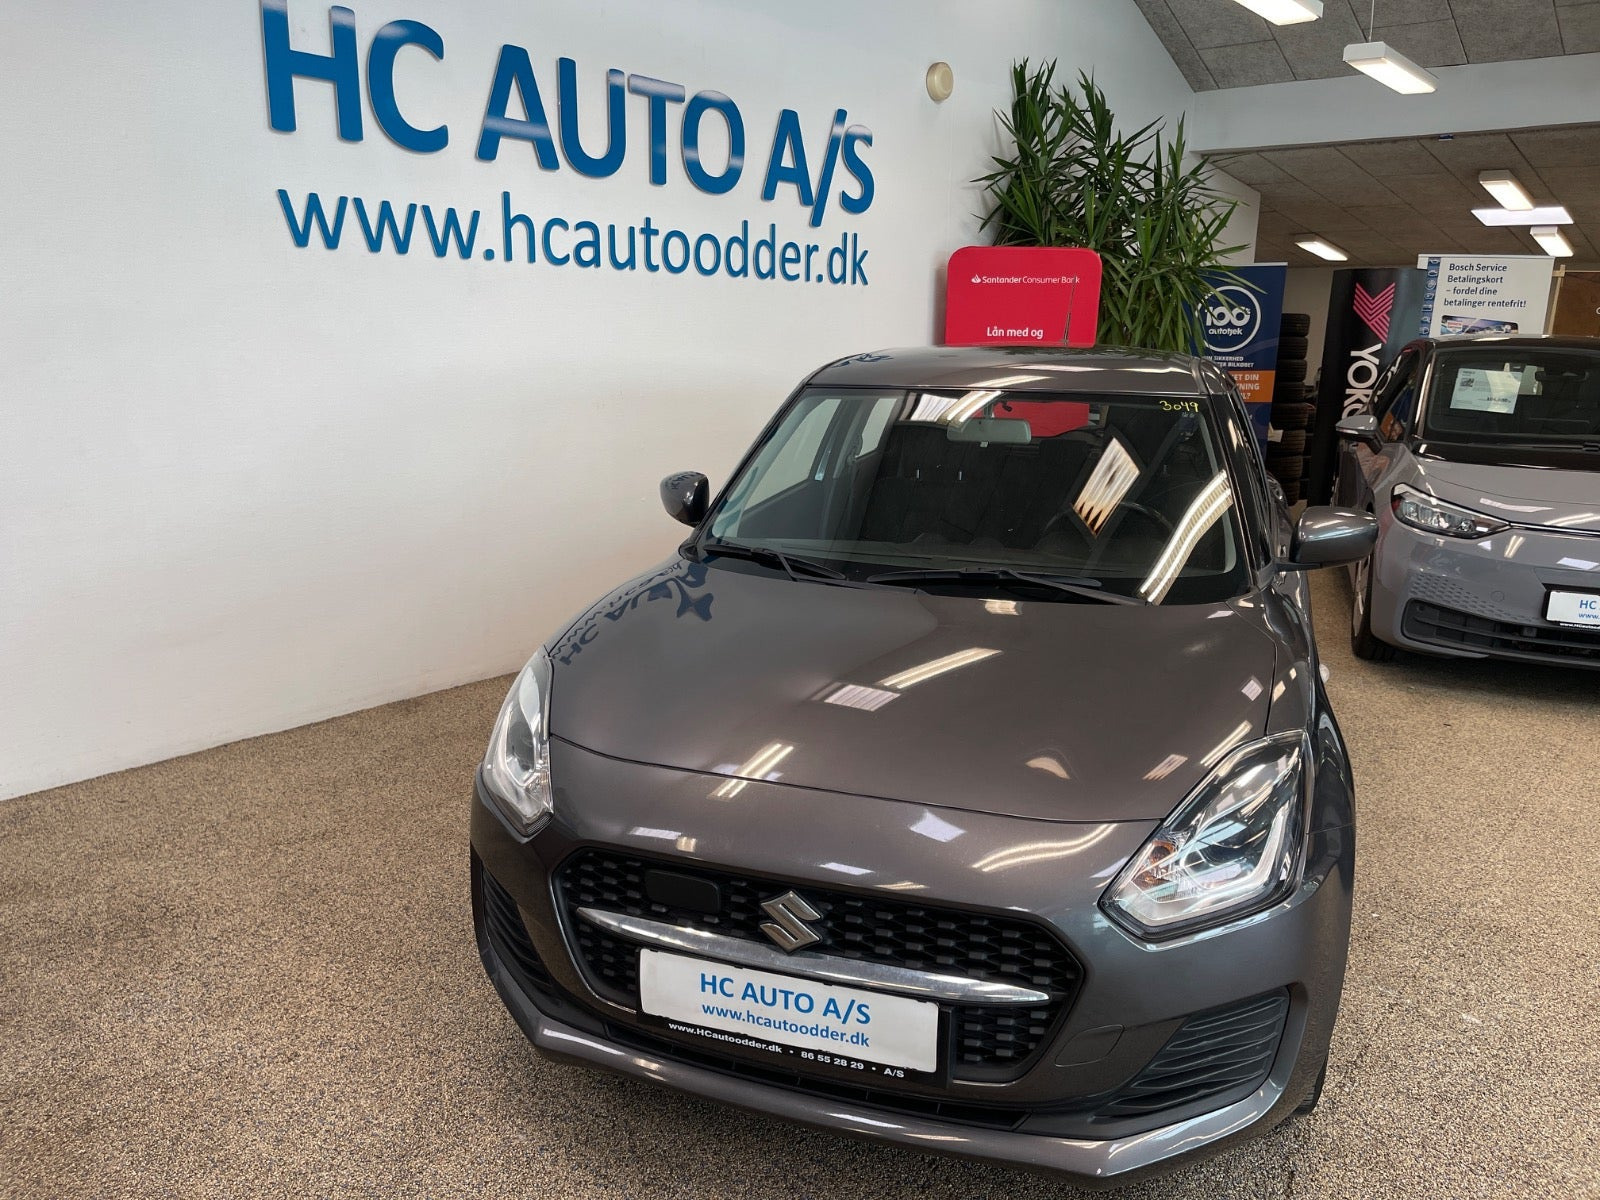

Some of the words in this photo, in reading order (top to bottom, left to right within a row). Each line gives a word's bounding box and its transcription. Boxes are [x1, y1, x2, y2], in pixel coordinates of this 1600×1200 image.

[260, 0, 449, 153] HC
[476, 44, 745, 194] AUTO
[764, 108, 874, 227] A/S
[277, 188, 869, 286] www.hcautoodder.dk
[1449, 263, 1474, 271] Bosch
[1476, 264, 1507, 272] Service
[982, 276, 1021, 284] Santander
[1023, 276, 1060, 284] Consumer
[1447, 275, 1503, 284] Betalingskort
[1453, 287, 1477, 295] fordel
[1479, 287, 1498, 296] dine
[1444, 298, 1486, 307] betalinger
[1488, 300, 1526, 308] rentefrit!
[987, 326, 1004, 337] Lån
[1007, 328, 1028, 337] med
[1031, 329, 1044, 339] og
[1159, 400, 1199, 413] 3049
[1580, 600, 1597, 610] HC
[699, 972, 735, 998] HC
[741, 982, 815, 1014] AUTO
[822, 997, 871, 1026] A/S
[702, 1003, 870, 1048] www.hcautoodder.dk
[668, 1022, 782, 1054] www.HCautoodder.dk
[801, 1051, 815, 1060] 86
[817, 1053, 831, 1063] 55
[833, 1057, 848, 1067] 28
[850, 1060, 864, 1070] 29
[883, 1068, 905, 1079] A/S
